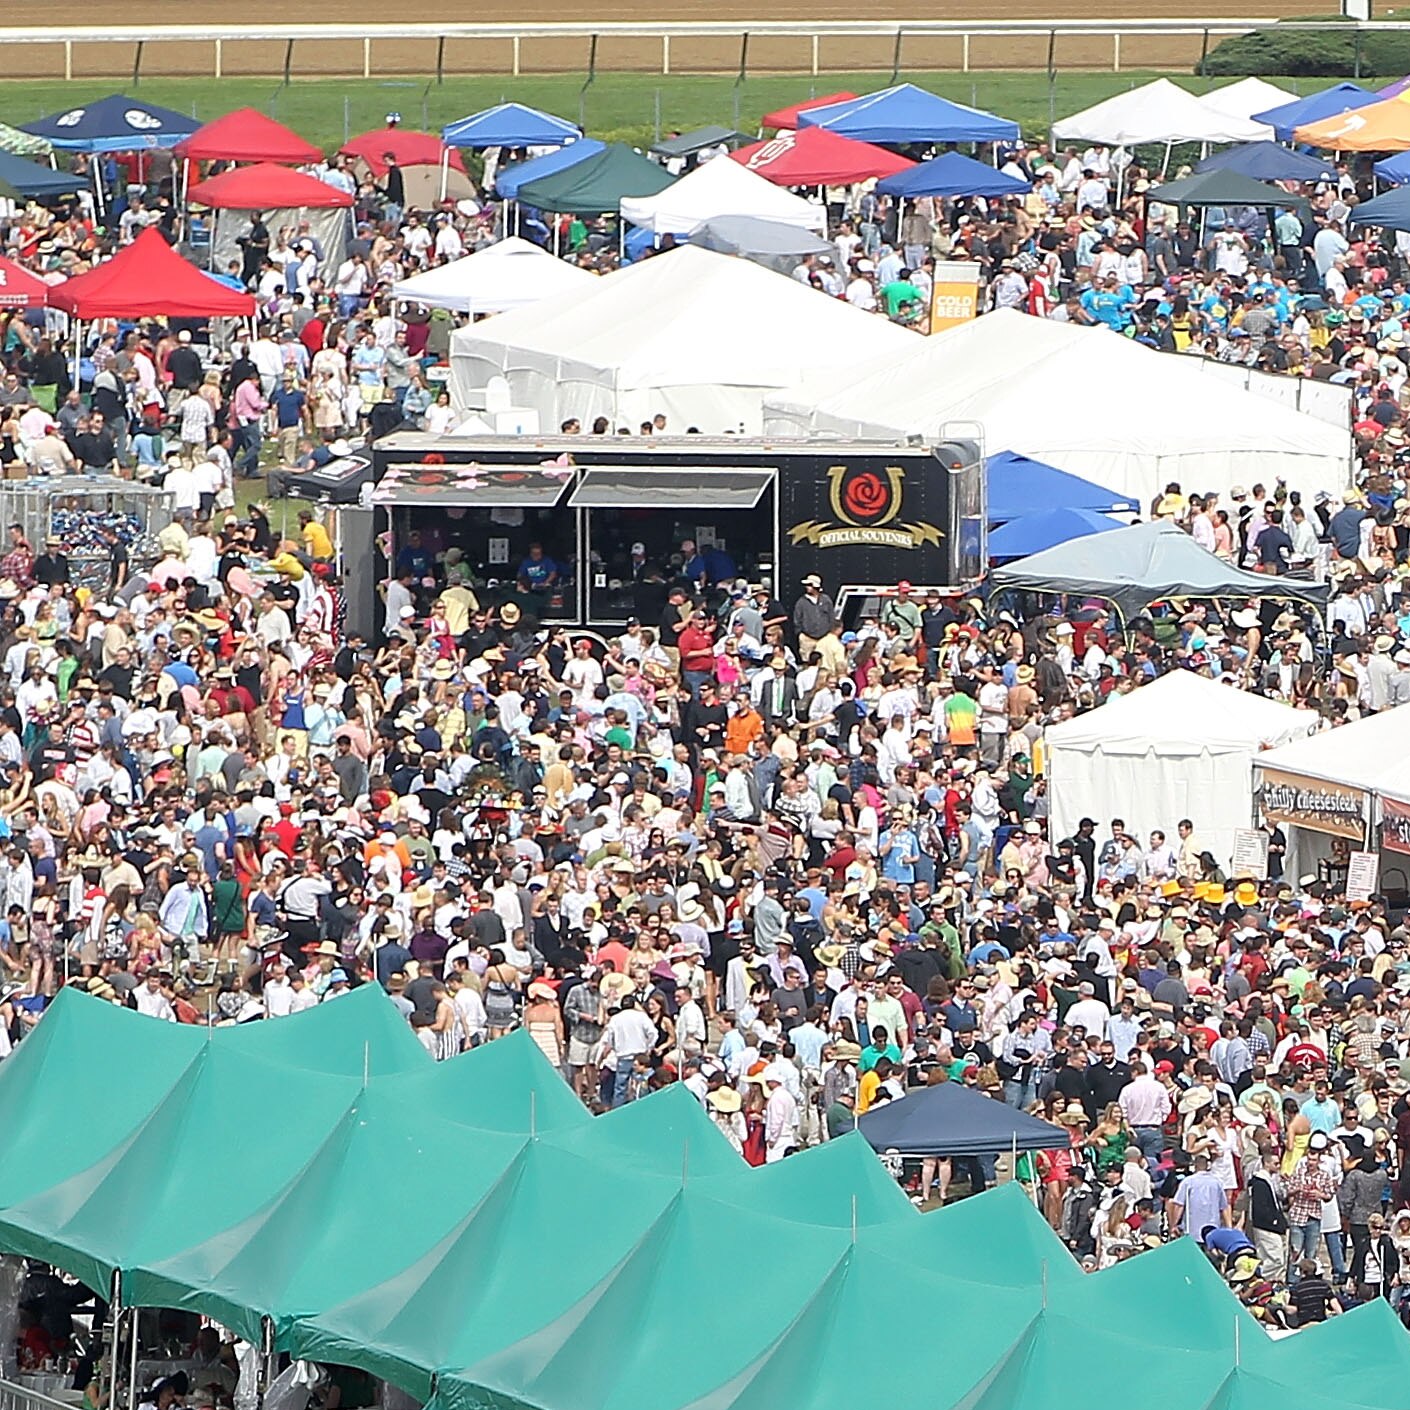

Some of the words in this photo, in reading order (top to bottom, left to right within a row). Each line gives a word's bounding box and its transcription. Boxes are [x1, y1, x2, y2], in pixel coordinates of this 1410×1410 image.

[937, 295, 973, 306] COLD
[937, 306, 971, 318] BEER
[820, 530, 861, 545] OFFICIAL
[862, 530, 912, 545] SOUVENIRS
[1265, 786, 1297, 809] philly
[1297, 791, 1359, 813] cheesesteak
